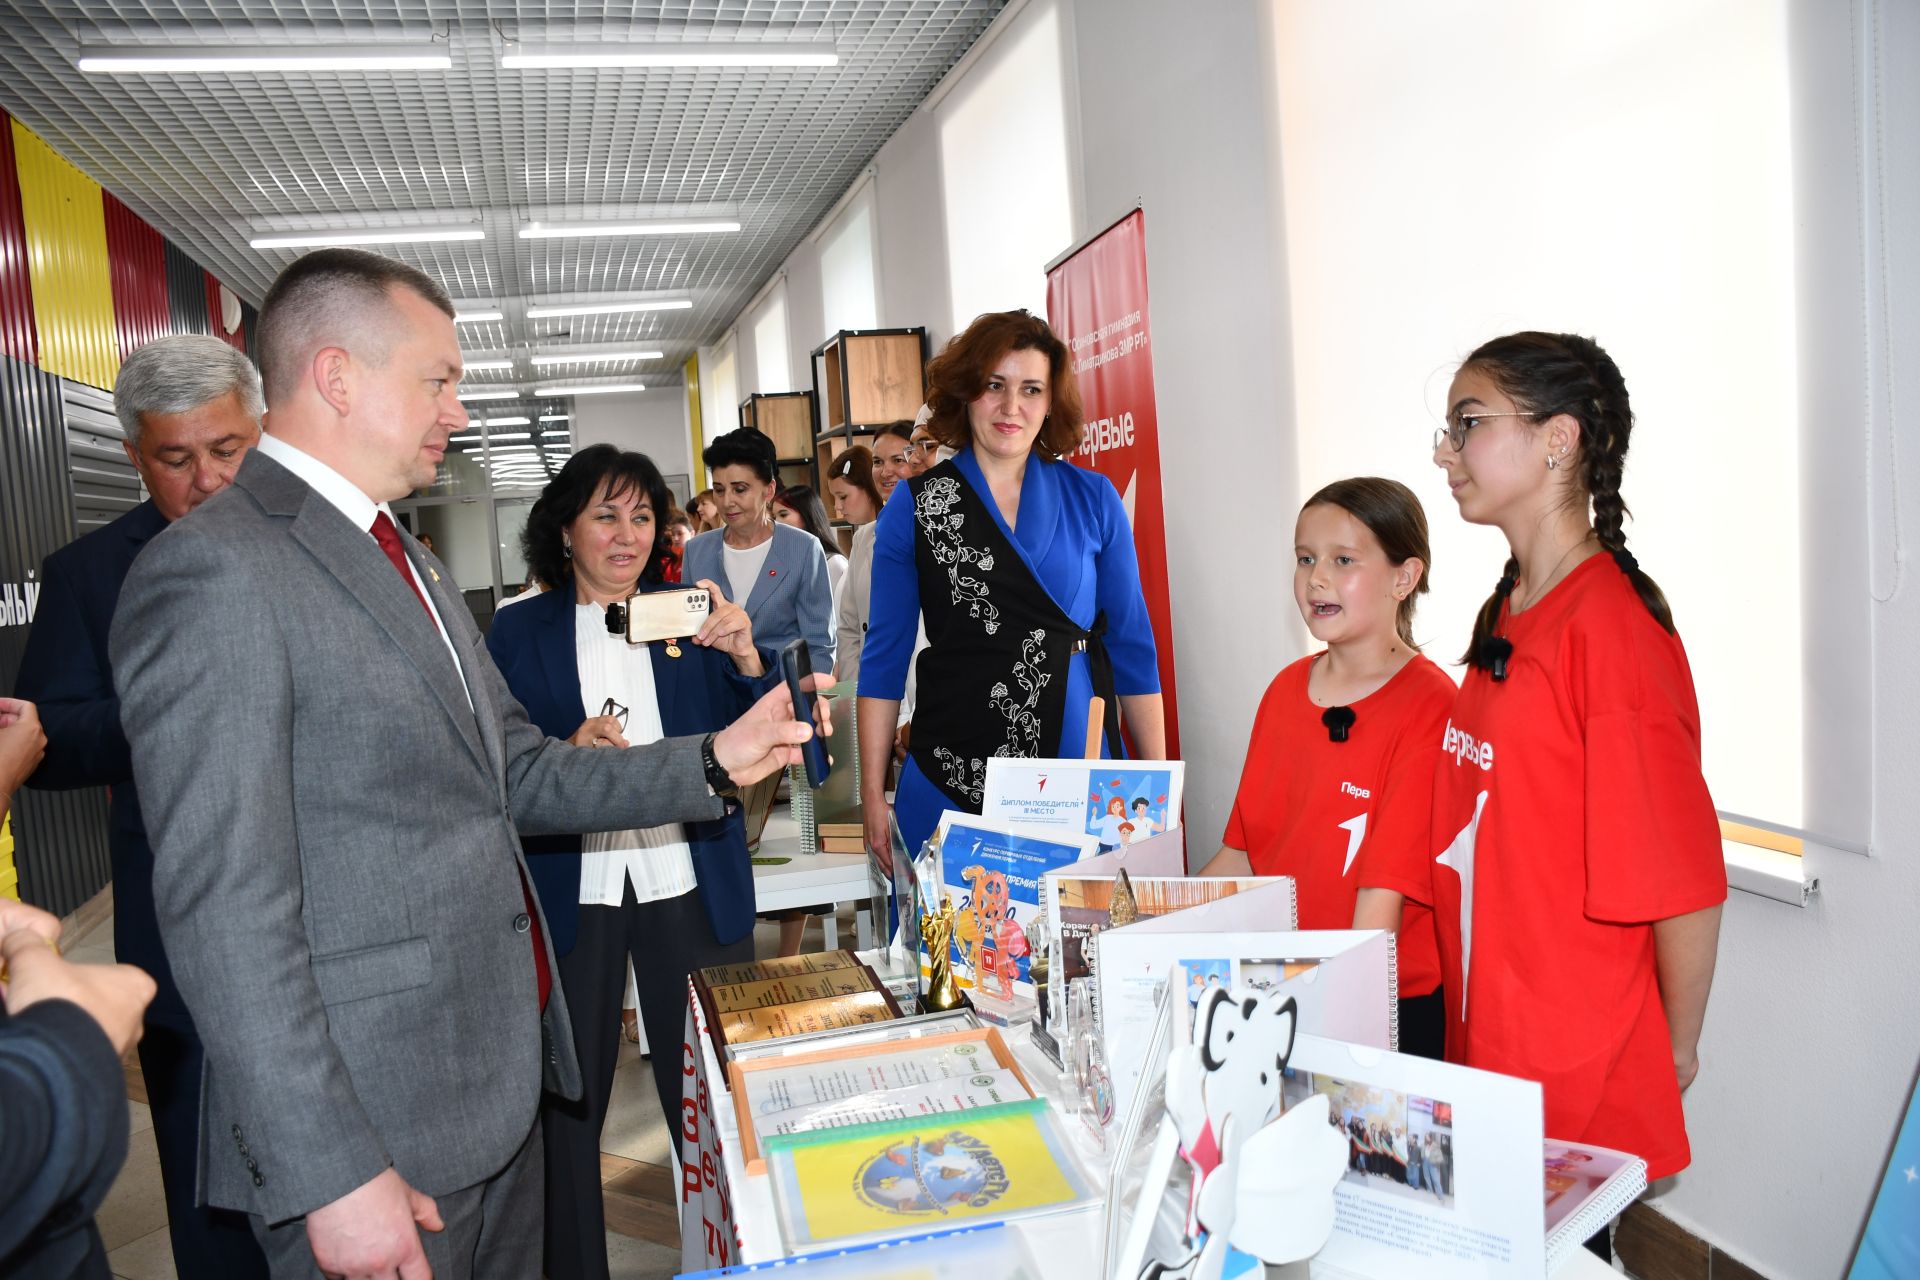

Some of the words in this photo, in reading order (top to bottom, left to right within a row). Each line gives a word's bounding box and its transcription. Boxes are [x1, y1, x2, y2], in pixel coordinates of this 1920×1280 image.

[1070, 412, 1135, 467] ервые
[1000, 799, 1032, 807] ДИПЛОМ
[1032, 800, 1079, 808] ПОБЕДИТЕЛЯ
[1006, 875, 1037, 889] ПРЕМИЯ
